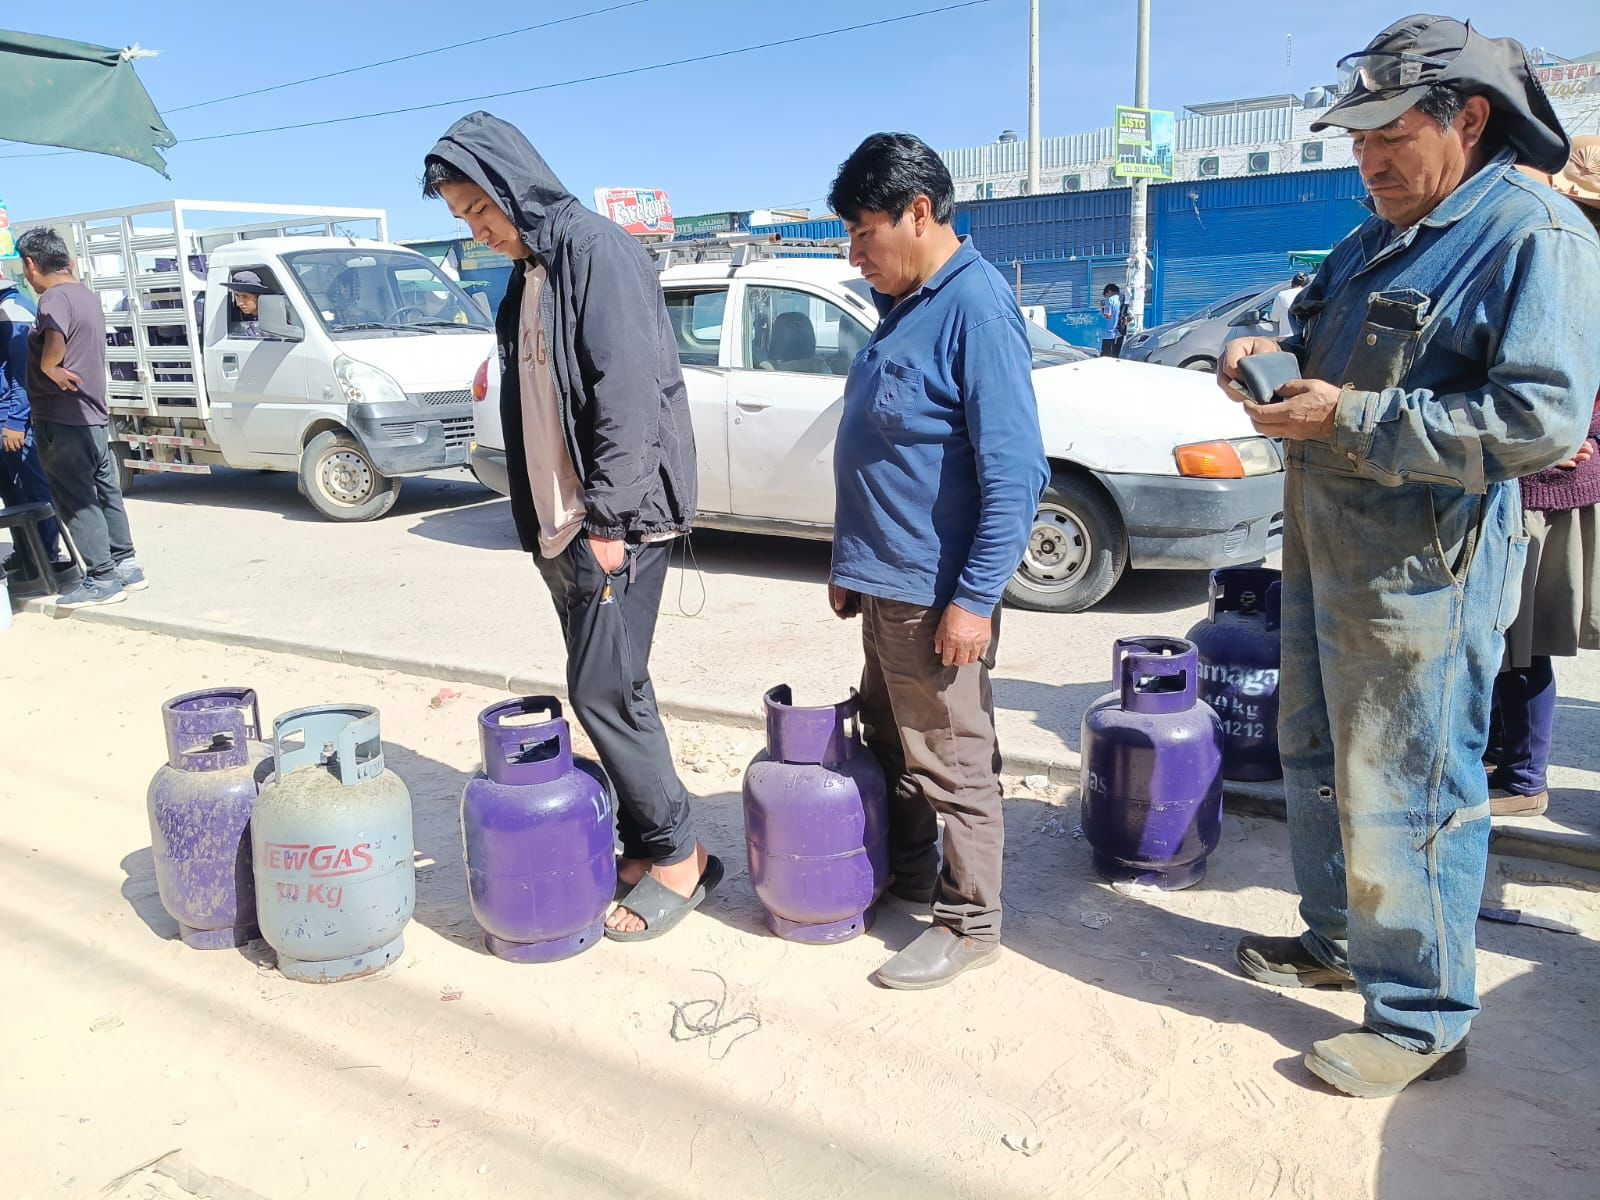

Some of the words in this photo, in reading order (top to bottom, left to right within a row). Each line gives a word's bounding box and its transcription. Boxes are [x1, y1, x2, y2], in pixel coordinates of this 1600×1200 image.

[1119, 118, 1146, 128] LISTO
[676, 223, 693, 233] DYS
[693, 223, 731, 232] SEGUNDOS
[697, 219, 726, 227] CALDOS
[1232, 697, 1259, 720] kg
[305, 882, 345, 909] Kg
